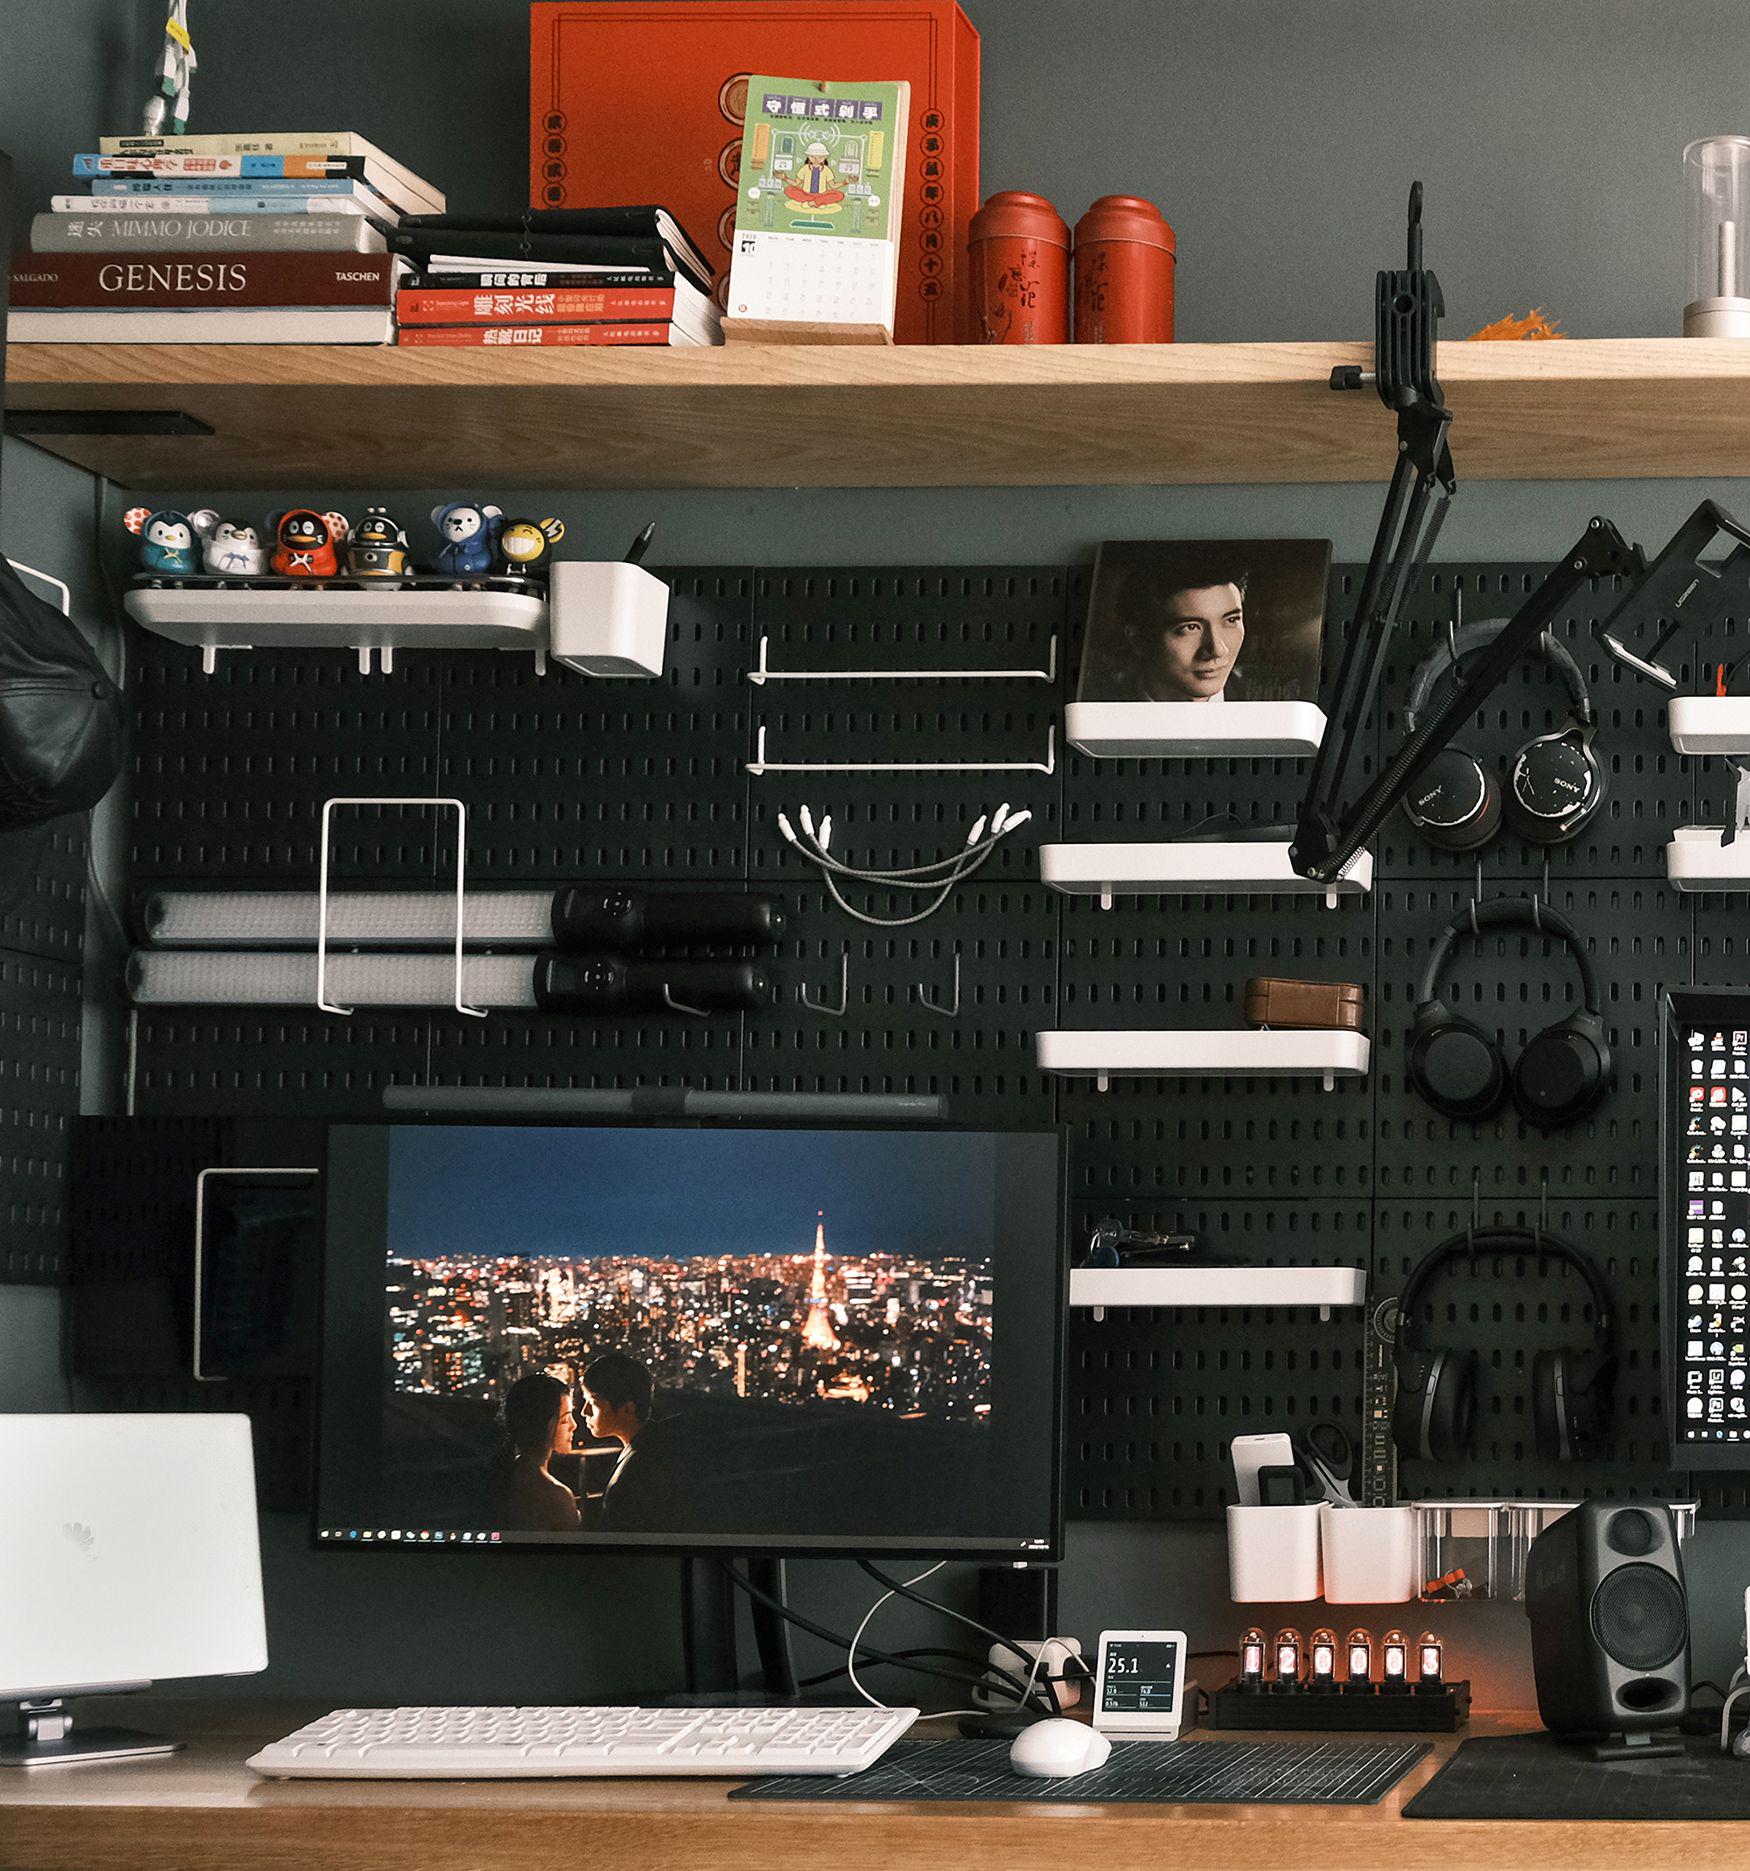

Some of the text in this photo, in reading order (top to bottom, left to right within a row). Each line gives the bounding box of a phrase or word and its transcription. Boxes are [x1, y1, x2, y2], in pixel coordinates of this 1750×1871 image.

[112, 219, 182, 237] MIMMO
[186, 219, 252, 239] JODICE
[99, 263, 247, 292] GENESIS
[335, 271, 380, 282] TASCHEN
[473, 293, 556, 317] 雕刻光线
[1553, 776, 1581, 793] SONY
[1418, 784, 1443, 806] SONY
[1108, 1657, 1139, 1674] 25.1
